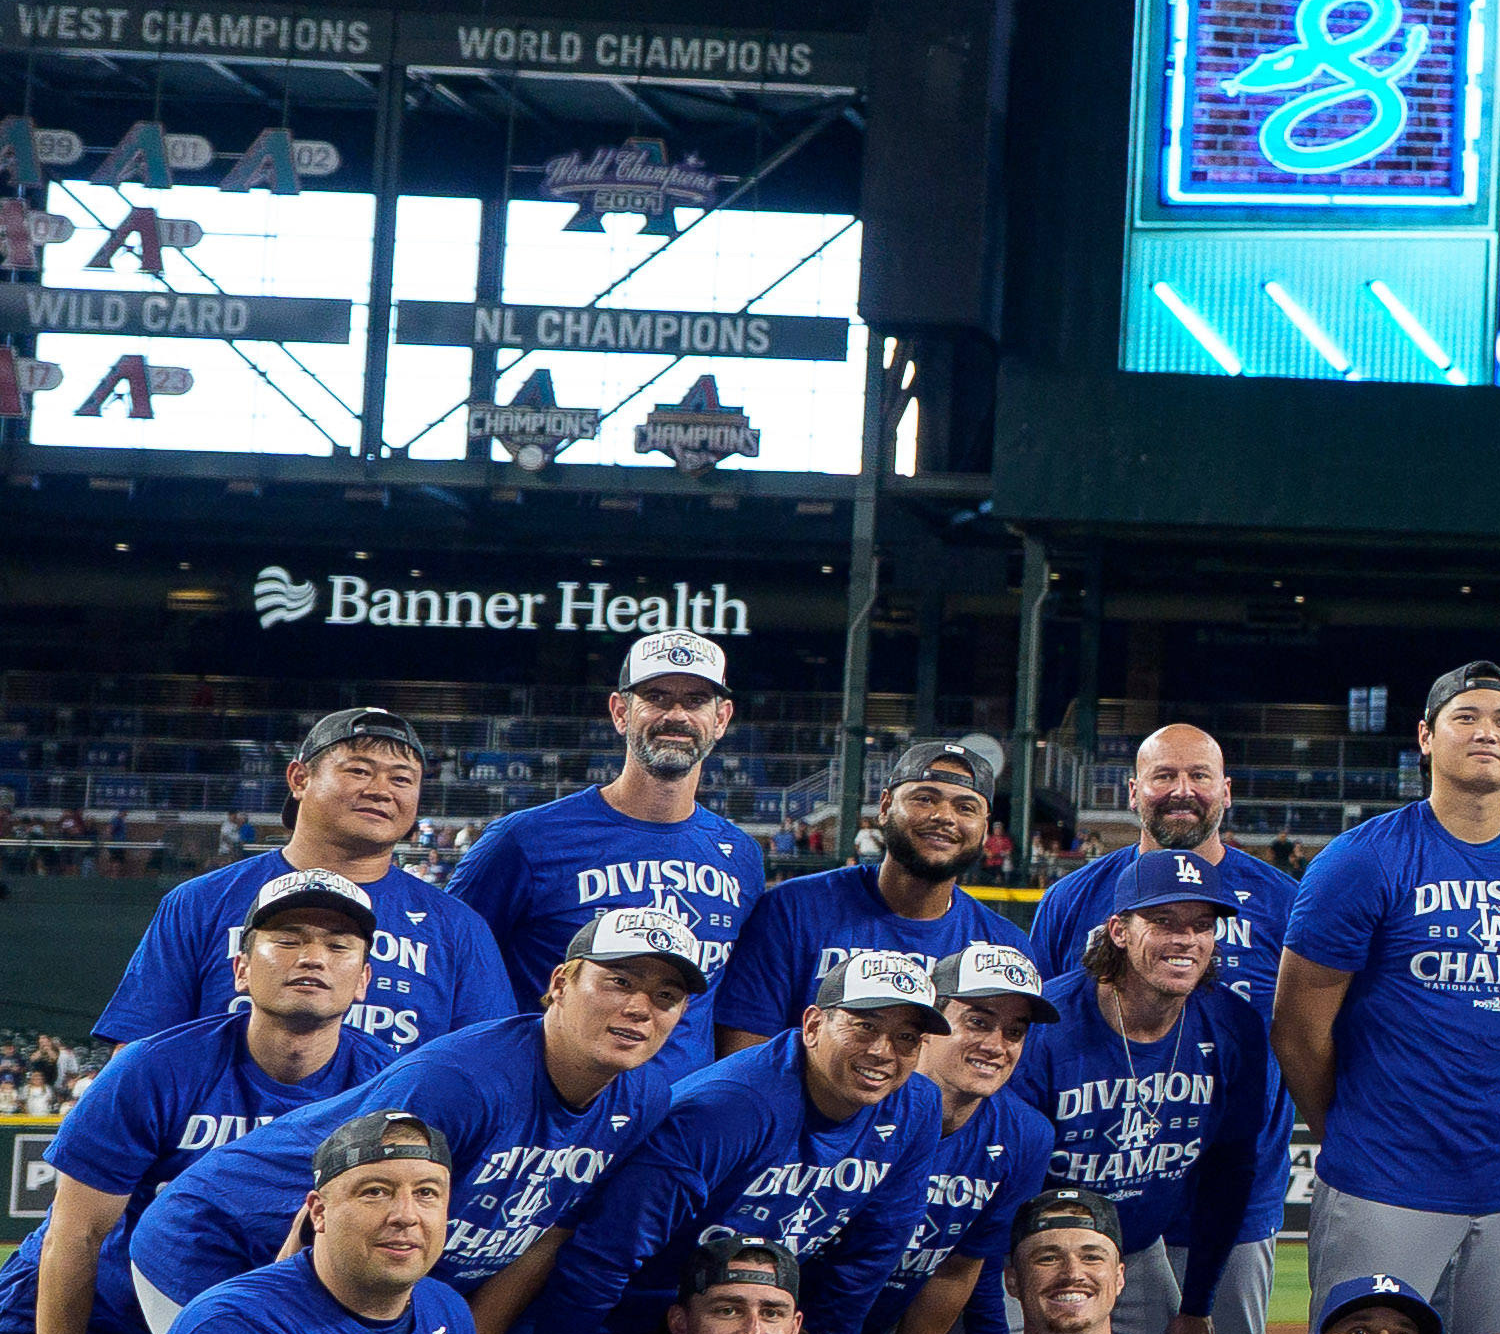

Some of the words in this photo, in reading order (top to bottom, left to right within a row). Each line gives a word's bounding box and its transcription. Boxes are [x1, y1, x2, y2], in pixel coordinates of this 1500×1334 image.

[18, 5, 128, 41] WEST
[141, 14, 371, 54] CHAMPIONS
[458, 26, 583, 64] WORLD
[595, 34, 813, 76] CHAMPIONS
[547, 149, 615, 186] World
[615, 146, 716, 189] Champions
[26, 293, 127, 328] WILD
[142, 297, 249, 333] CARD
[474, 308, 523, 343] NL
[536, 312, 771, 354] CHAMPIONS
[468, 408, 598, 440] CHAMPIONS
[636, 422, 759, 457] CHAMPIONS
[326, 575, 545, 629] Banner
[554, 581, 750, 635] Health
[1427, 924, 1459, 940] 20
[1056, 1071, 1214, 1121] DIVISION
